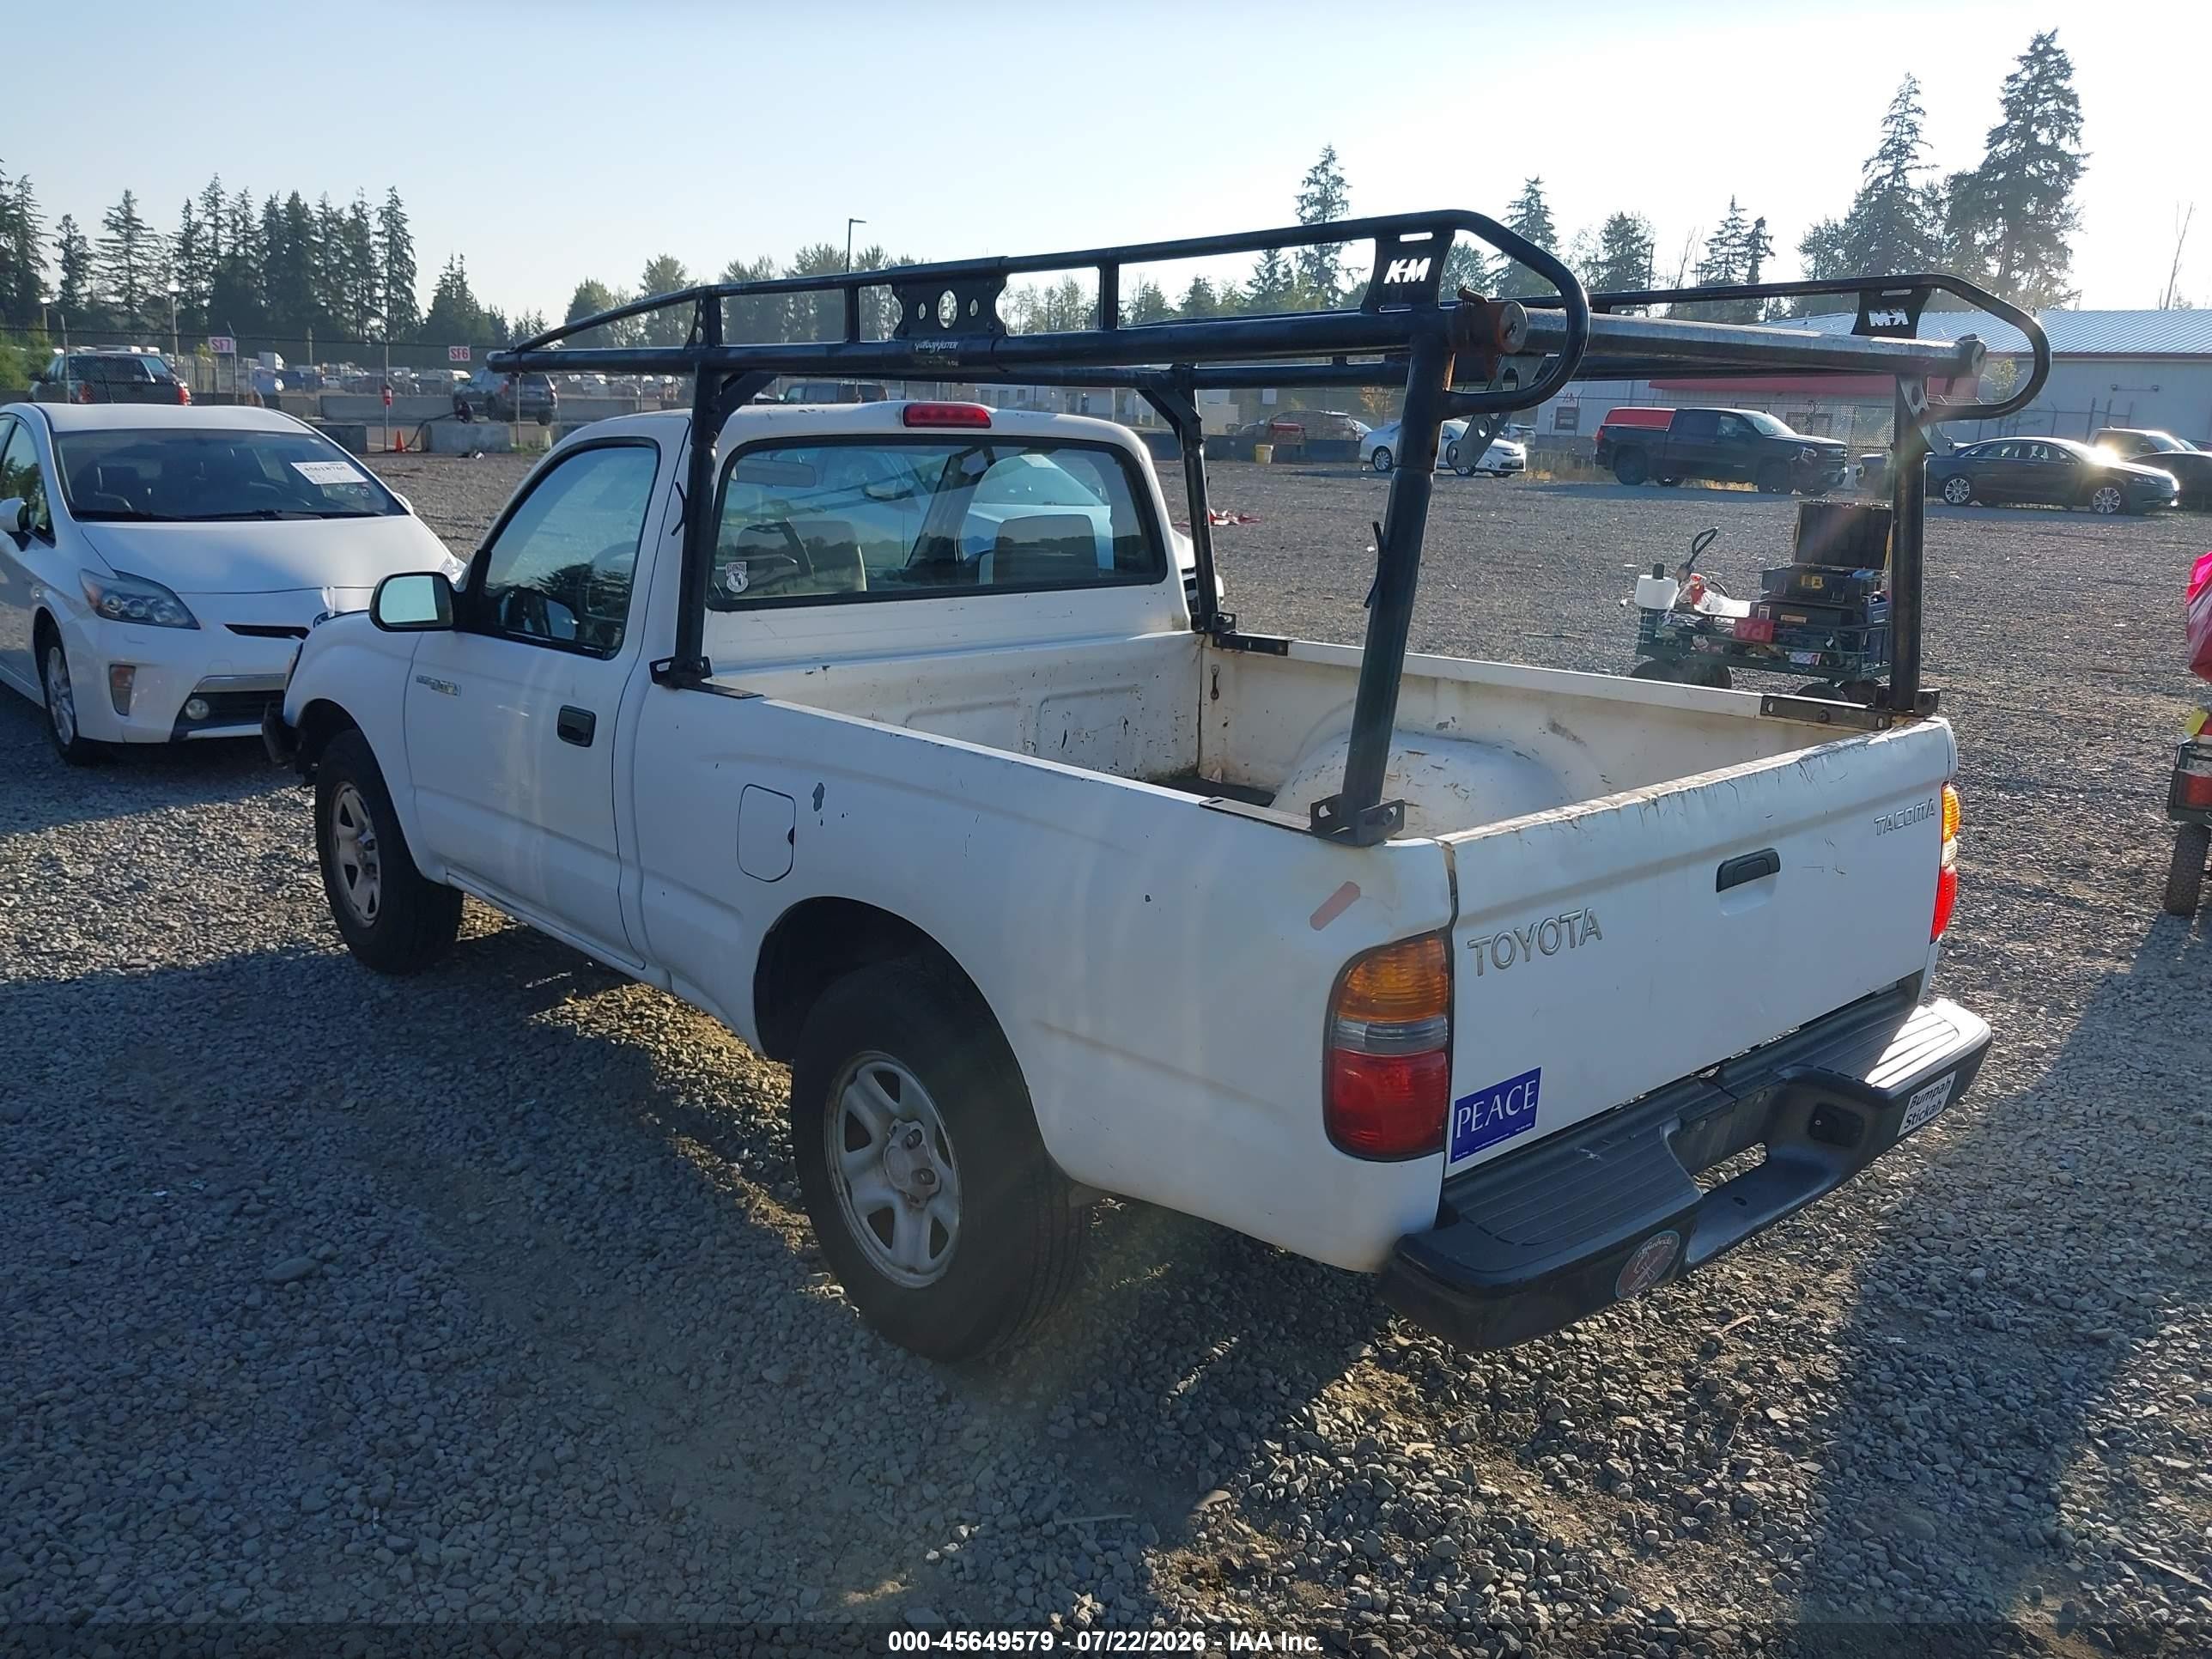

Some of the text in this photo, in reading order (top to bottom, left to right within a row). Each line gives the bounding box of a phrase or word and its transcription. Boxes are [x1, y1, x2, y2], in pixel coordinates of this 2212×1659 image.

[211, 338, 231, 351] SF7
[450, 347, 469, 359] SF6
[1874, 798, 1936, 836] TACOMA
[1467, 907, 1603, 976] TOYOTA
[1456, 1079, 1536, 1139] PEACE
[1910, 1078, 1951, 1109] Bumpah
[1904, 1099, 1942, 1129] Stickah
